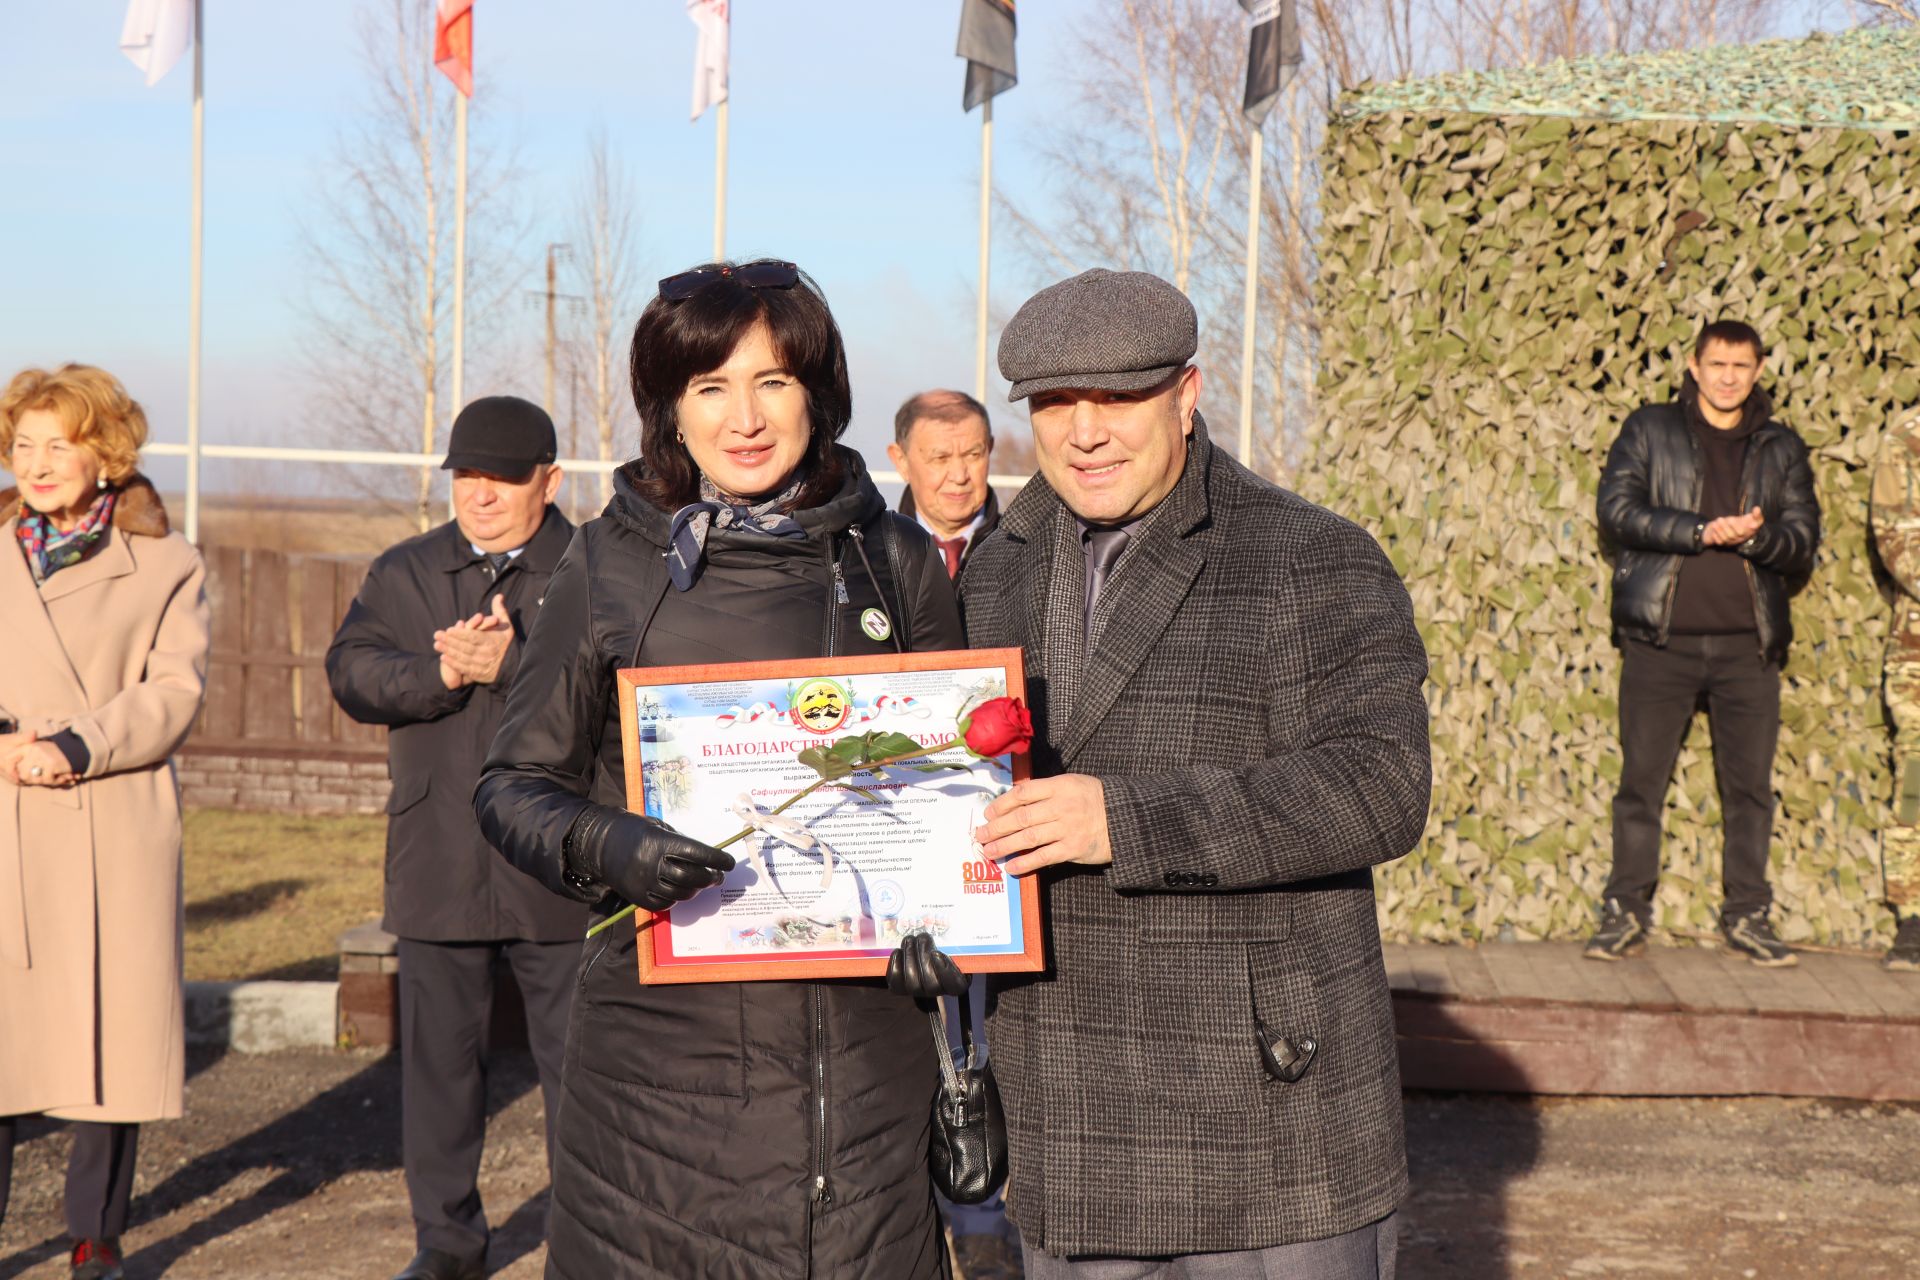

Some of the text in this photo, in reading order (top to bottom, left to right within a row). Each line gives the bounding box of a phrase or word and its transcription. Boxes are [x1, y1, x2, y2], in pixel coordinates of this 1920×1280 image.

[821, 813, 855, 821] поддержка
[855, 830, 880, 838] успехов
[963, 883, 1005, 895] ПОБЕДА!
